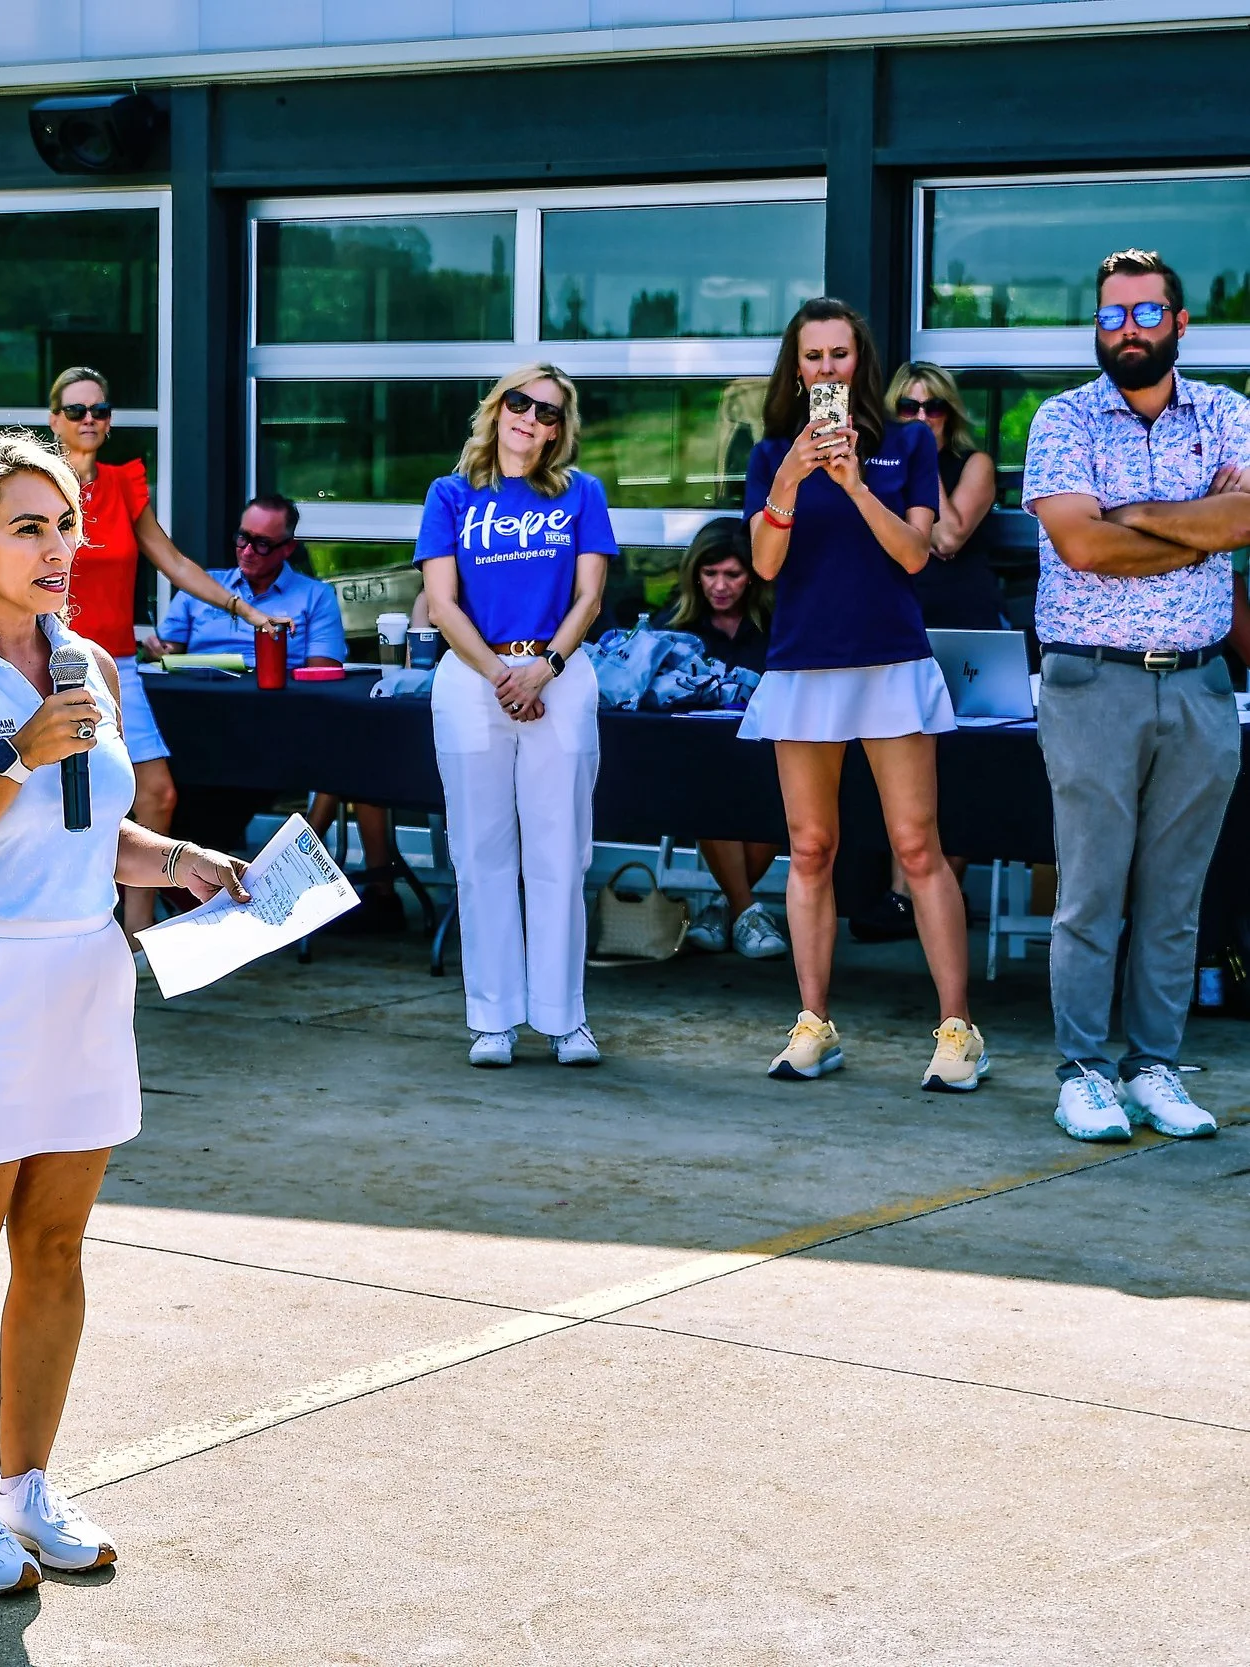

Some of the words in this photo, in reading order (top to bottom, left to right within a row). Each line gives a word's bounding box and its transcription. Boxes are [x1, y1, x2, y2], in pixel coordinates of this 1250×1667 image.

[459, 501, 572, 549] Hope
[475, 548, 557, 566] bradenshope.org
[963, 661, 979, 683] hp
[312, 849, 332, 875] BRICE
